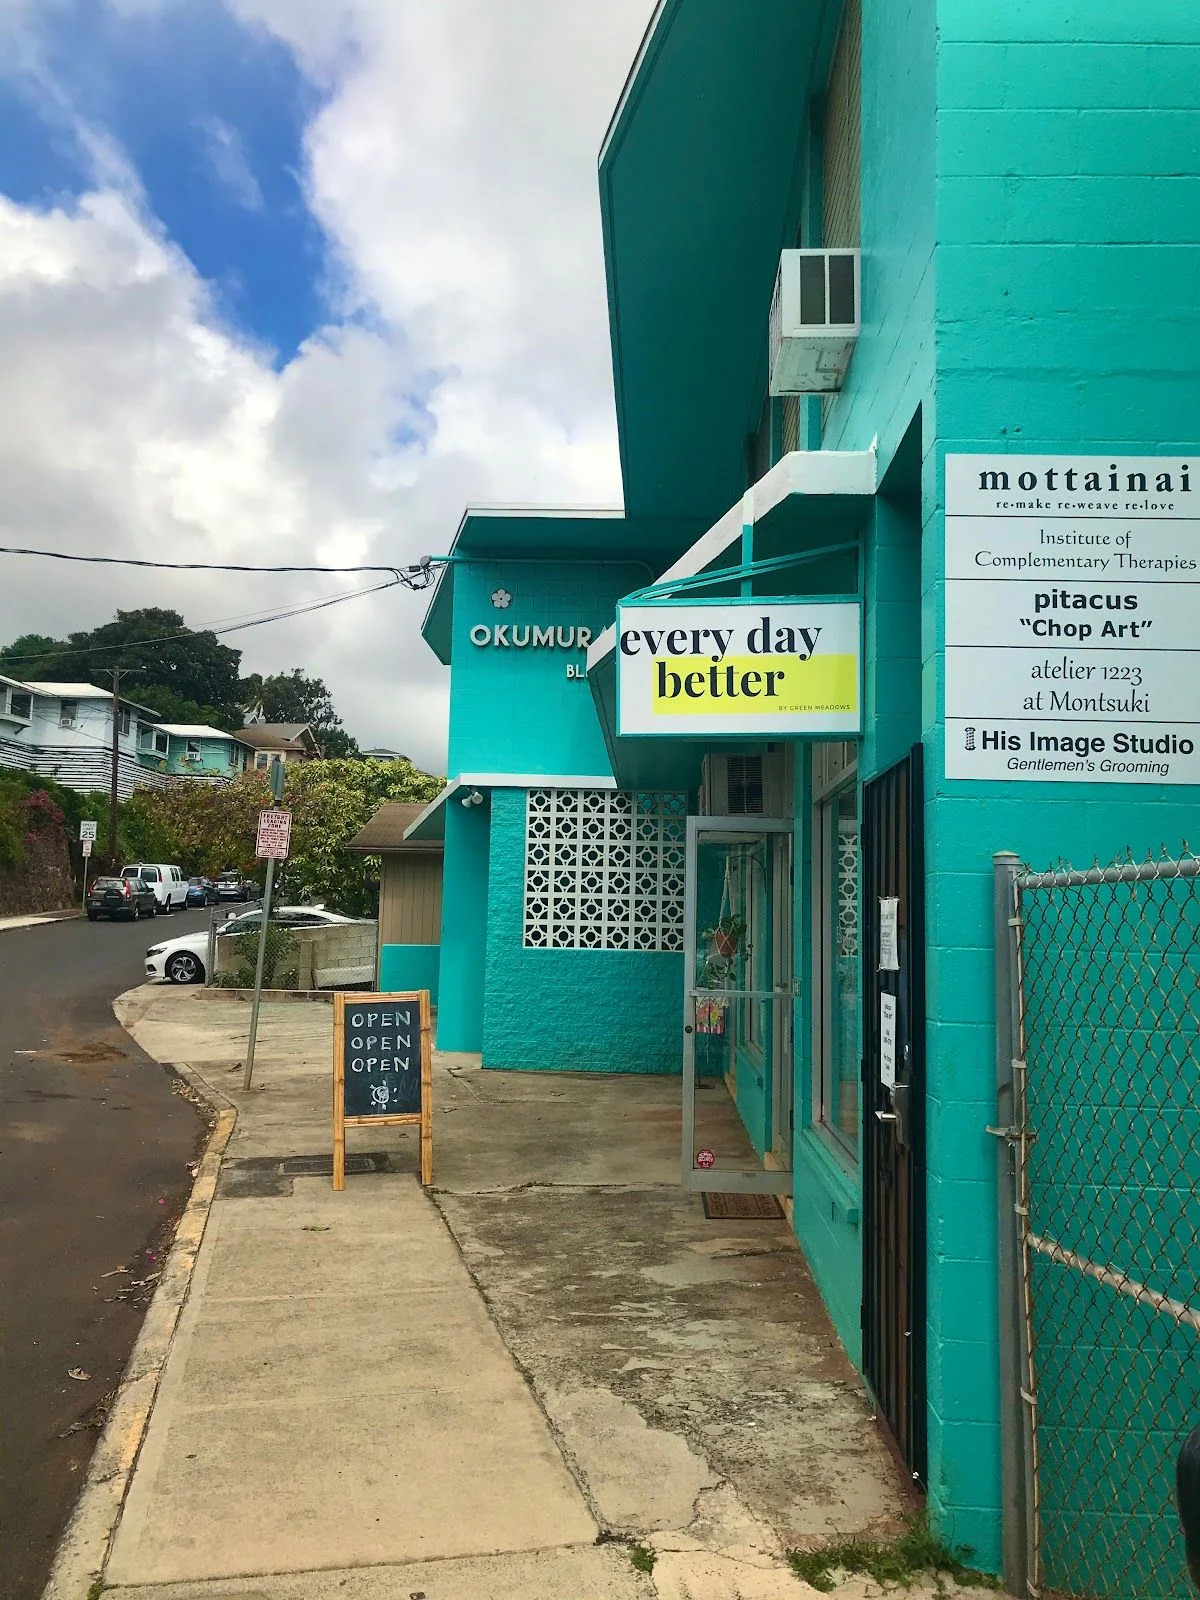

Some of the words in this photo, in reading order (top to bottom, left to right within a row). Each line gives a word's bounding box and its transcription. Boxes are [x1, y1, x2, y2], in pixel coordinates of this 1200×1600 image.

[979, 464, 1191, 492] mottainai
[1041, 529, 1110, 544] Institute
[1116, 531, 1131, 548] of
[975, 551, 1109, 571] Complementary
[1114, 554, 1196, 572] Therapies
[1035, 589, 1137, 613] pitacus
[470, 624, 607, 648] OKUMUR
[620, 625, 734, 662] every
[747, 617, 822, 661] day
[567, 664, 588, 678] BL
[658, 661, 785, 698] better
[1032, 656, 1096, 679] atelier
[1101, 667, 1142, 686] 1223
[1024, 692, 1044, 710] at
[1050, 689, 1150, 712] Montsuki
[983, 731, 1021, 750] His
[1030, 732, 1105, 757] Image
[1113, 733, 1194, 754] Studio
[1008, 756, 1095, 771] Gentlemen's
[1100, 760, 1169, 776] Grooming
[351, 1011, 411, 1027] OPEN
[351, 1035, 411, 1050] OPEN
[351, 1057, 410, 1072] OPEN
